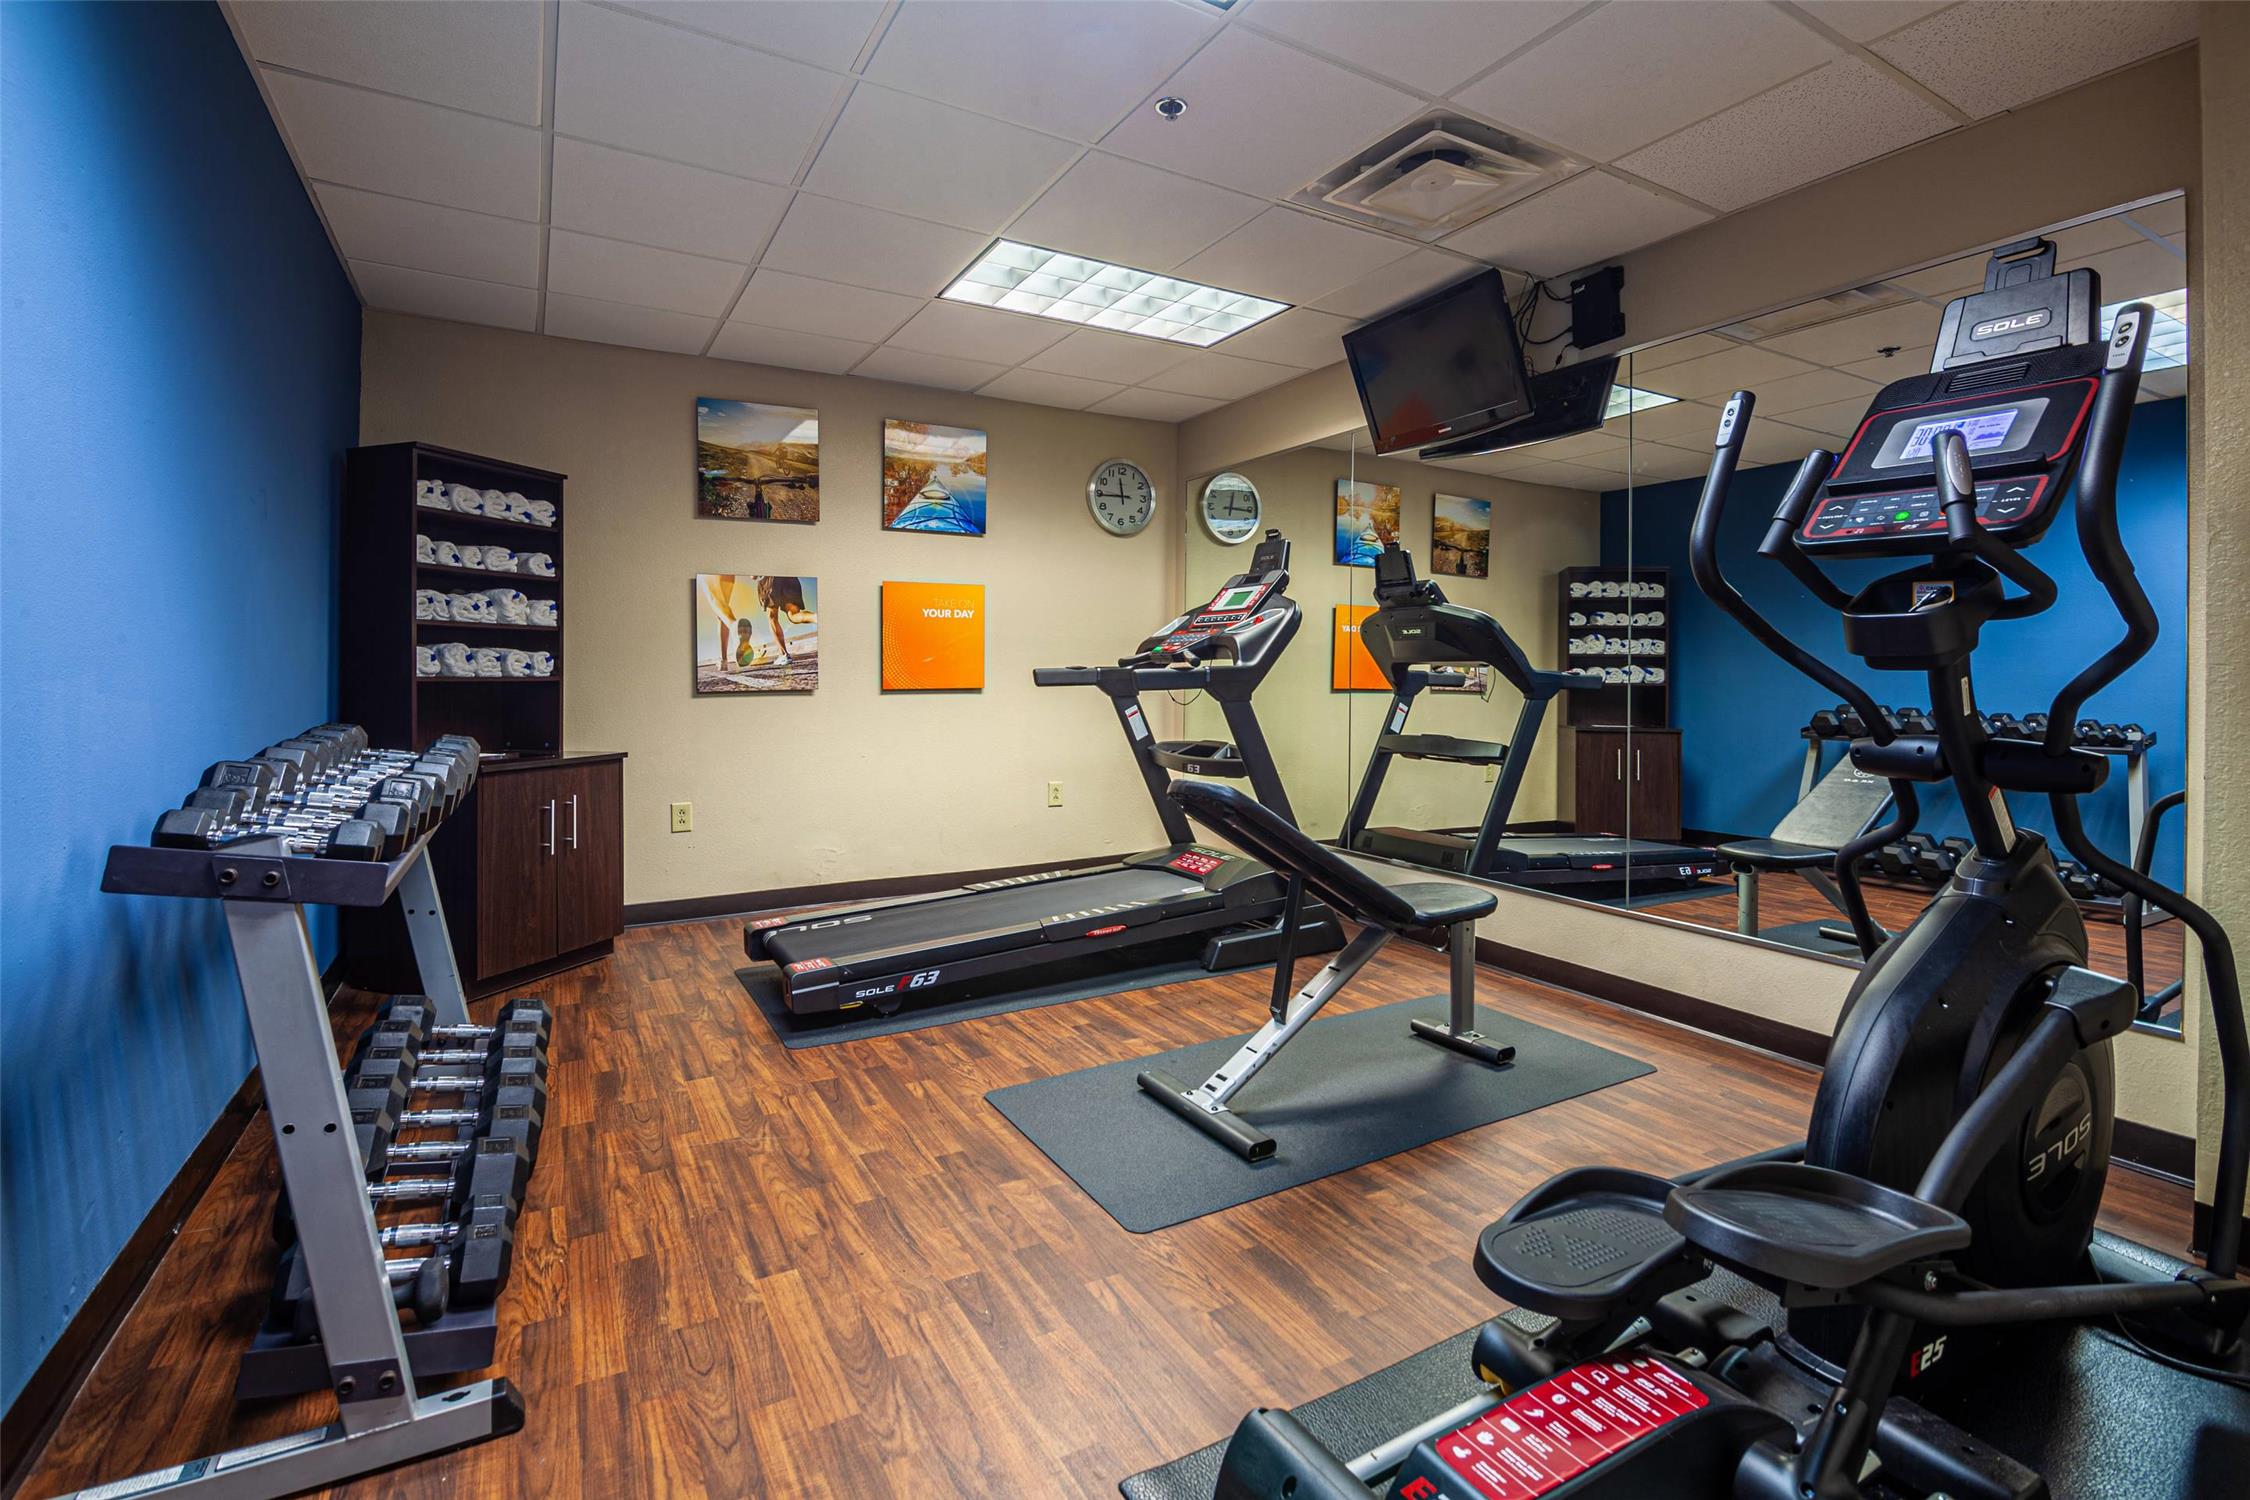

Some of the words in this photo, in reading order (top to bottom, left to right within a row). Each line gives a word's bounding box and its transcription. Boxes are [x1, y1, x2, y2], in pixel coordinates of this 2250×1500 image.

[1976, 313, 2043, 336] SOLE
[1108, 469, 1115, 477] 11
[1118, 467, 1127, 475] 12
[1137, 482, 1144, 490] 2
[1139, 495, 1146, 503] 3
[1099, 502, 1107, 510] 8
[1107, 512, 1114, 521] 7
[1129, 515, 1136, 523] 5
[1117, 518, 1125, 526] 6
[922, 608, 951, 618] YOUR
[954, 609, 975, 619] DAY
[1190, 847, 1236, 861] SOLE
[855, 984, 895, 998] SOLE
[2026, 1112, 2092, 1182] SOLE
[1910, 1335, 1947, 1378] E25
